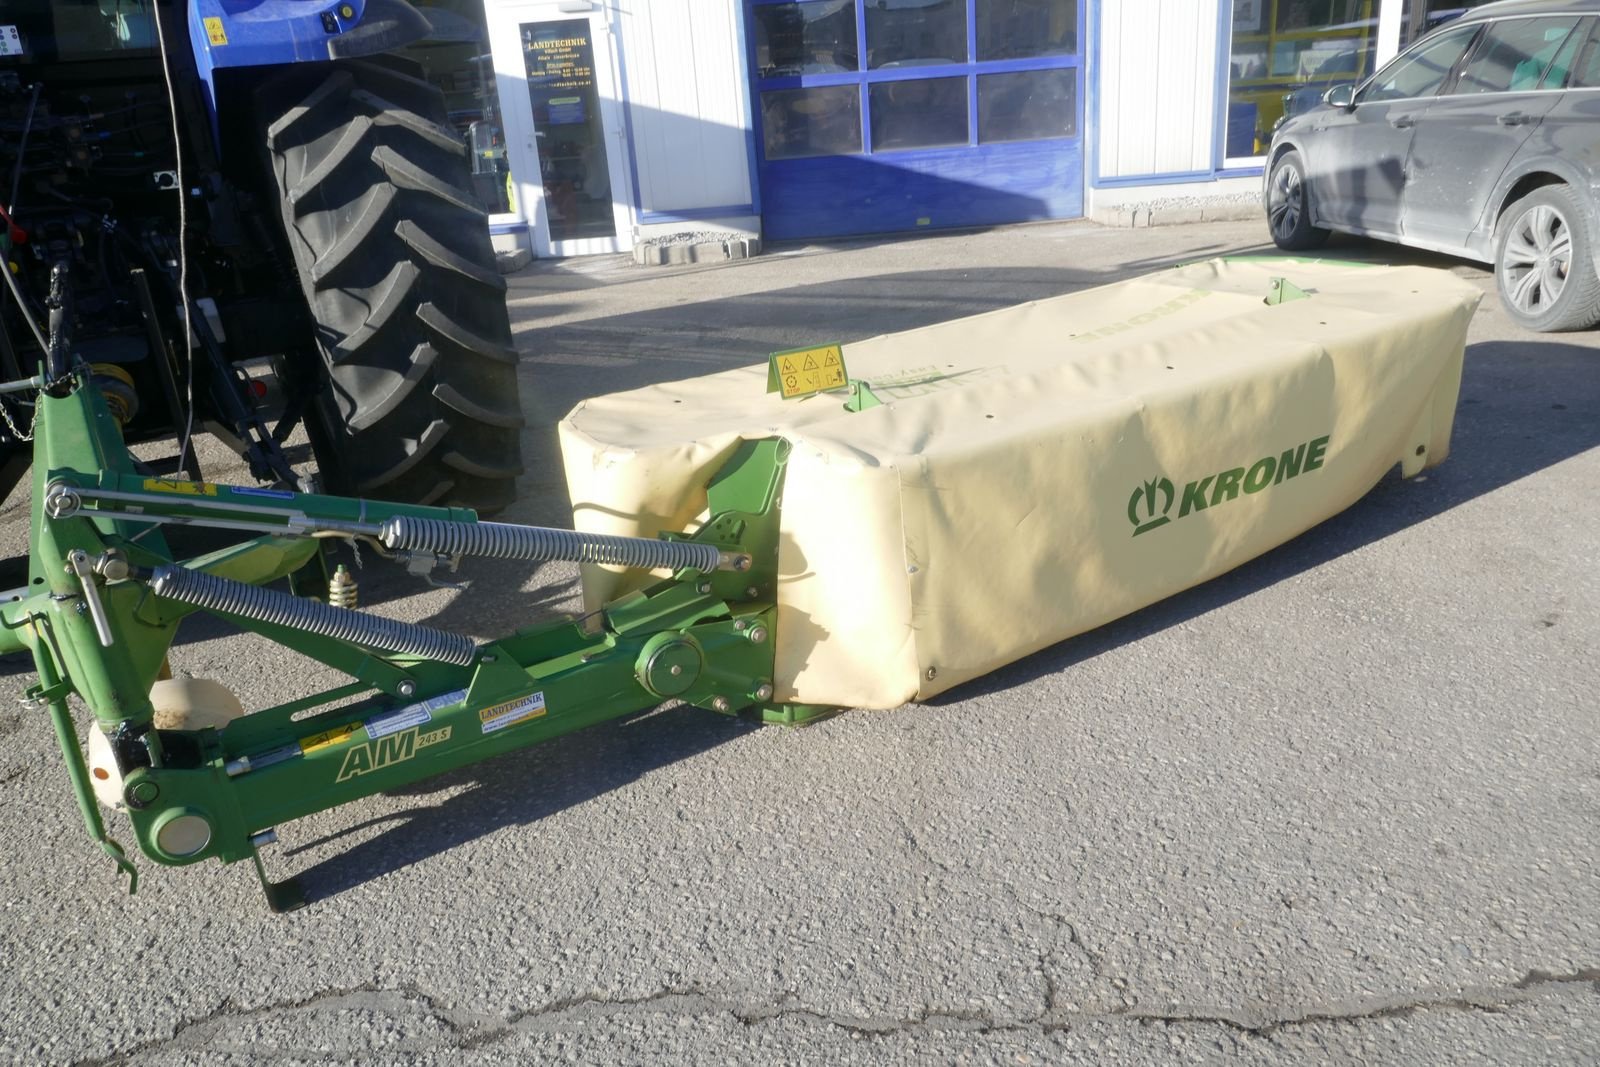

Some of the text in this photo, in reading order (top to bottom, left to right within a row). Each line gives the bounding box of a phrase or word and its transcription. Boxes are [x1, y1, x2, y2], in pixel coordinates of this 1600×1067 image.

[528, 38, 586, 50] LANDTECHNIK
[786, 387, 800, 395] STOP
[1178, 434, 1330, 519] KRONE
[481, 694, 542, 719] LANDTECHNIK
[335, 726, 448, 783] AM 243 S
